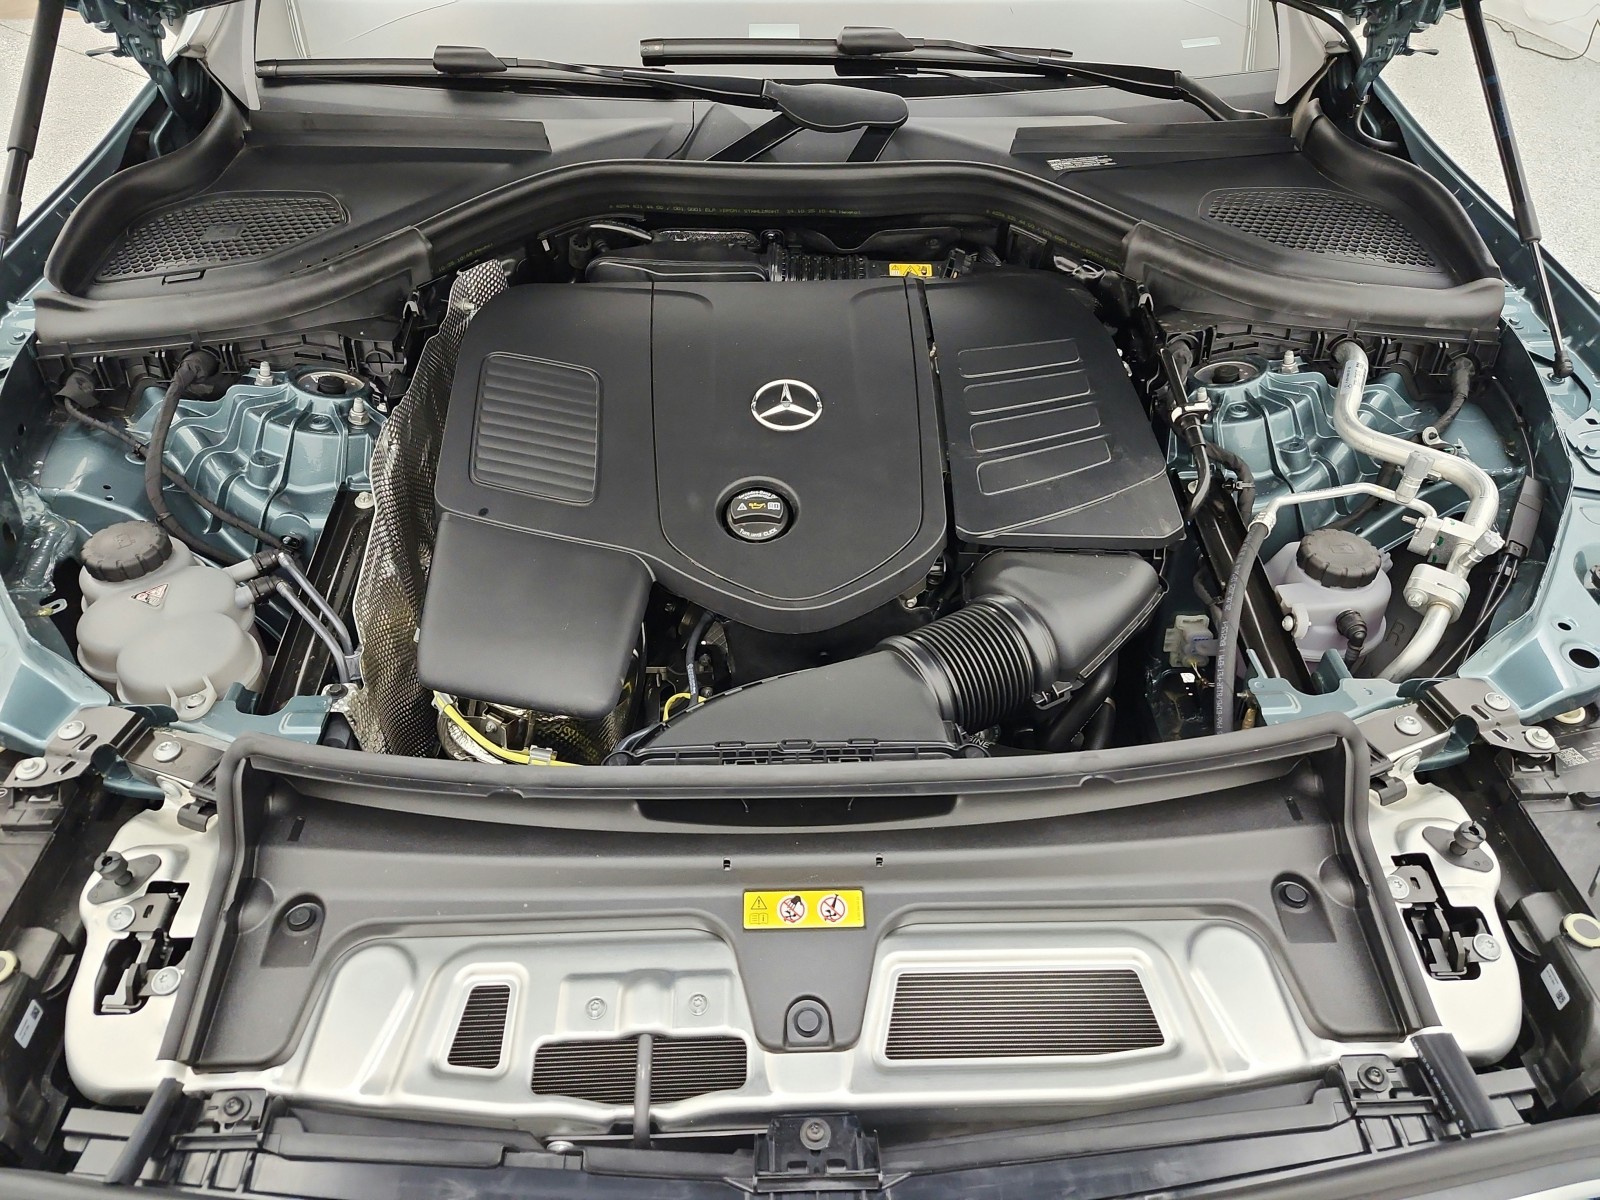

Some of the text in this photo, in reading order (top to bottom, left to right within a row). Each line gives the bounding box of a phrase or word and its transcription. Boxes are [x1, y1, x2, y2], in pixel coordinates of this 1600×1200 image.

[740, 528, 750, 537] Turn
[763, 528, 777, 536] CLICK
[1385, 620, 1405, 647] R
